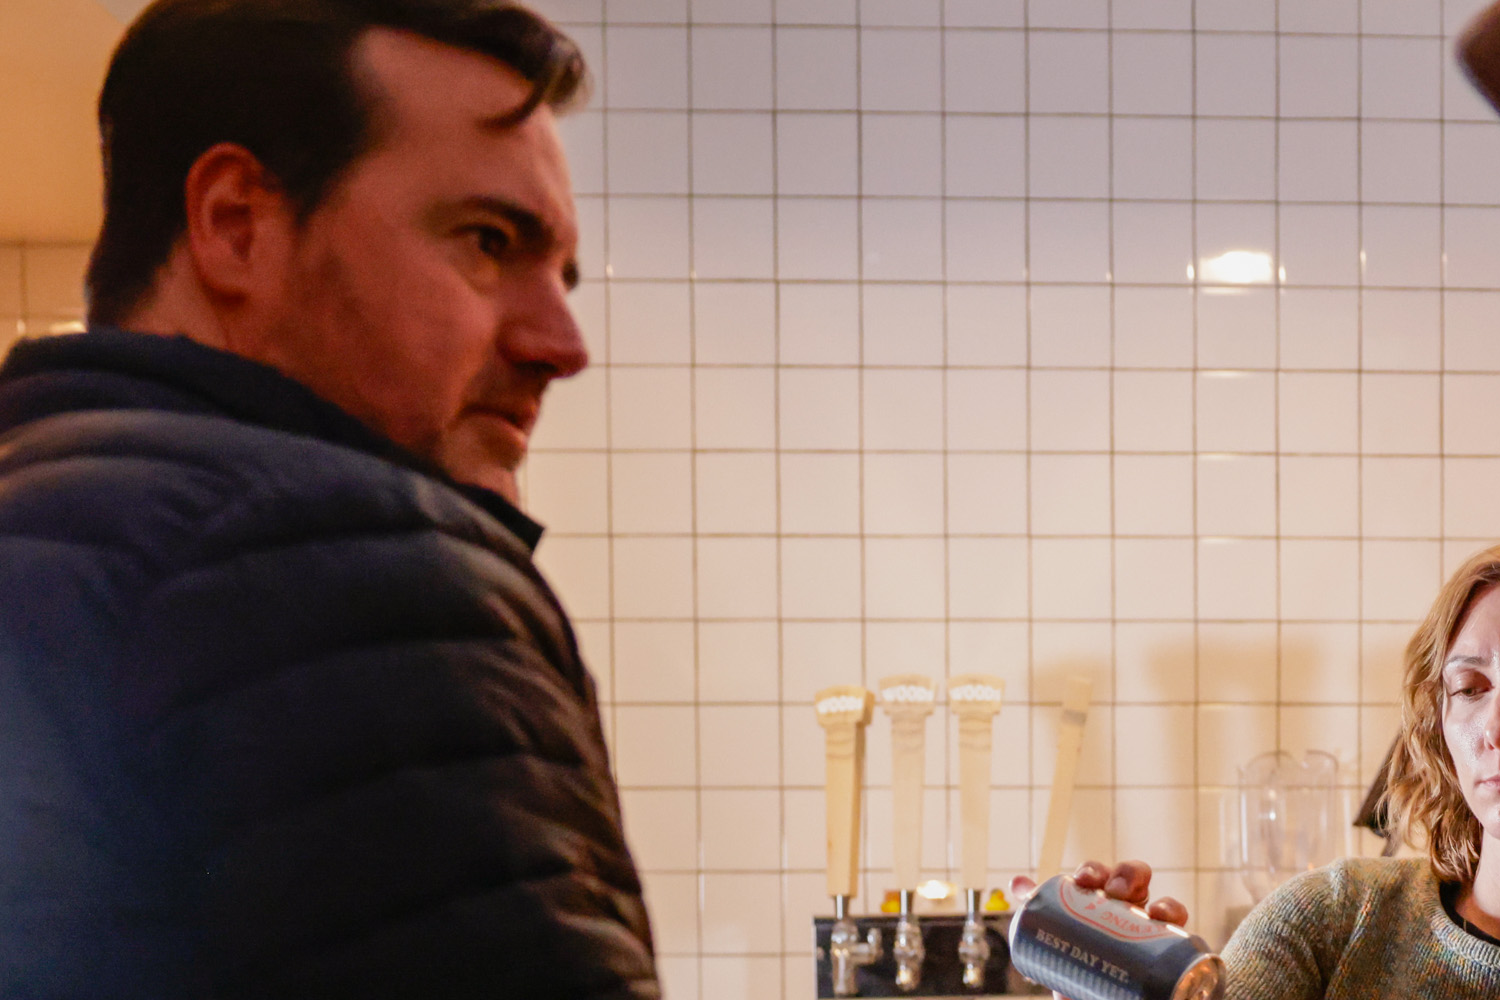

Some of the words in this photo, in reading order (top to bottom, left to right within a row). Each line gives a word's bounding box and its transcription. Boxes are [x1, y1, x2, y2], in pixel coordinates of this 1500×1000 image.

[1035, 928, 1071, 953] BEST
[1069, 945, 1100, 967] DAY
[1100, 959, 1130, 984] YET.
